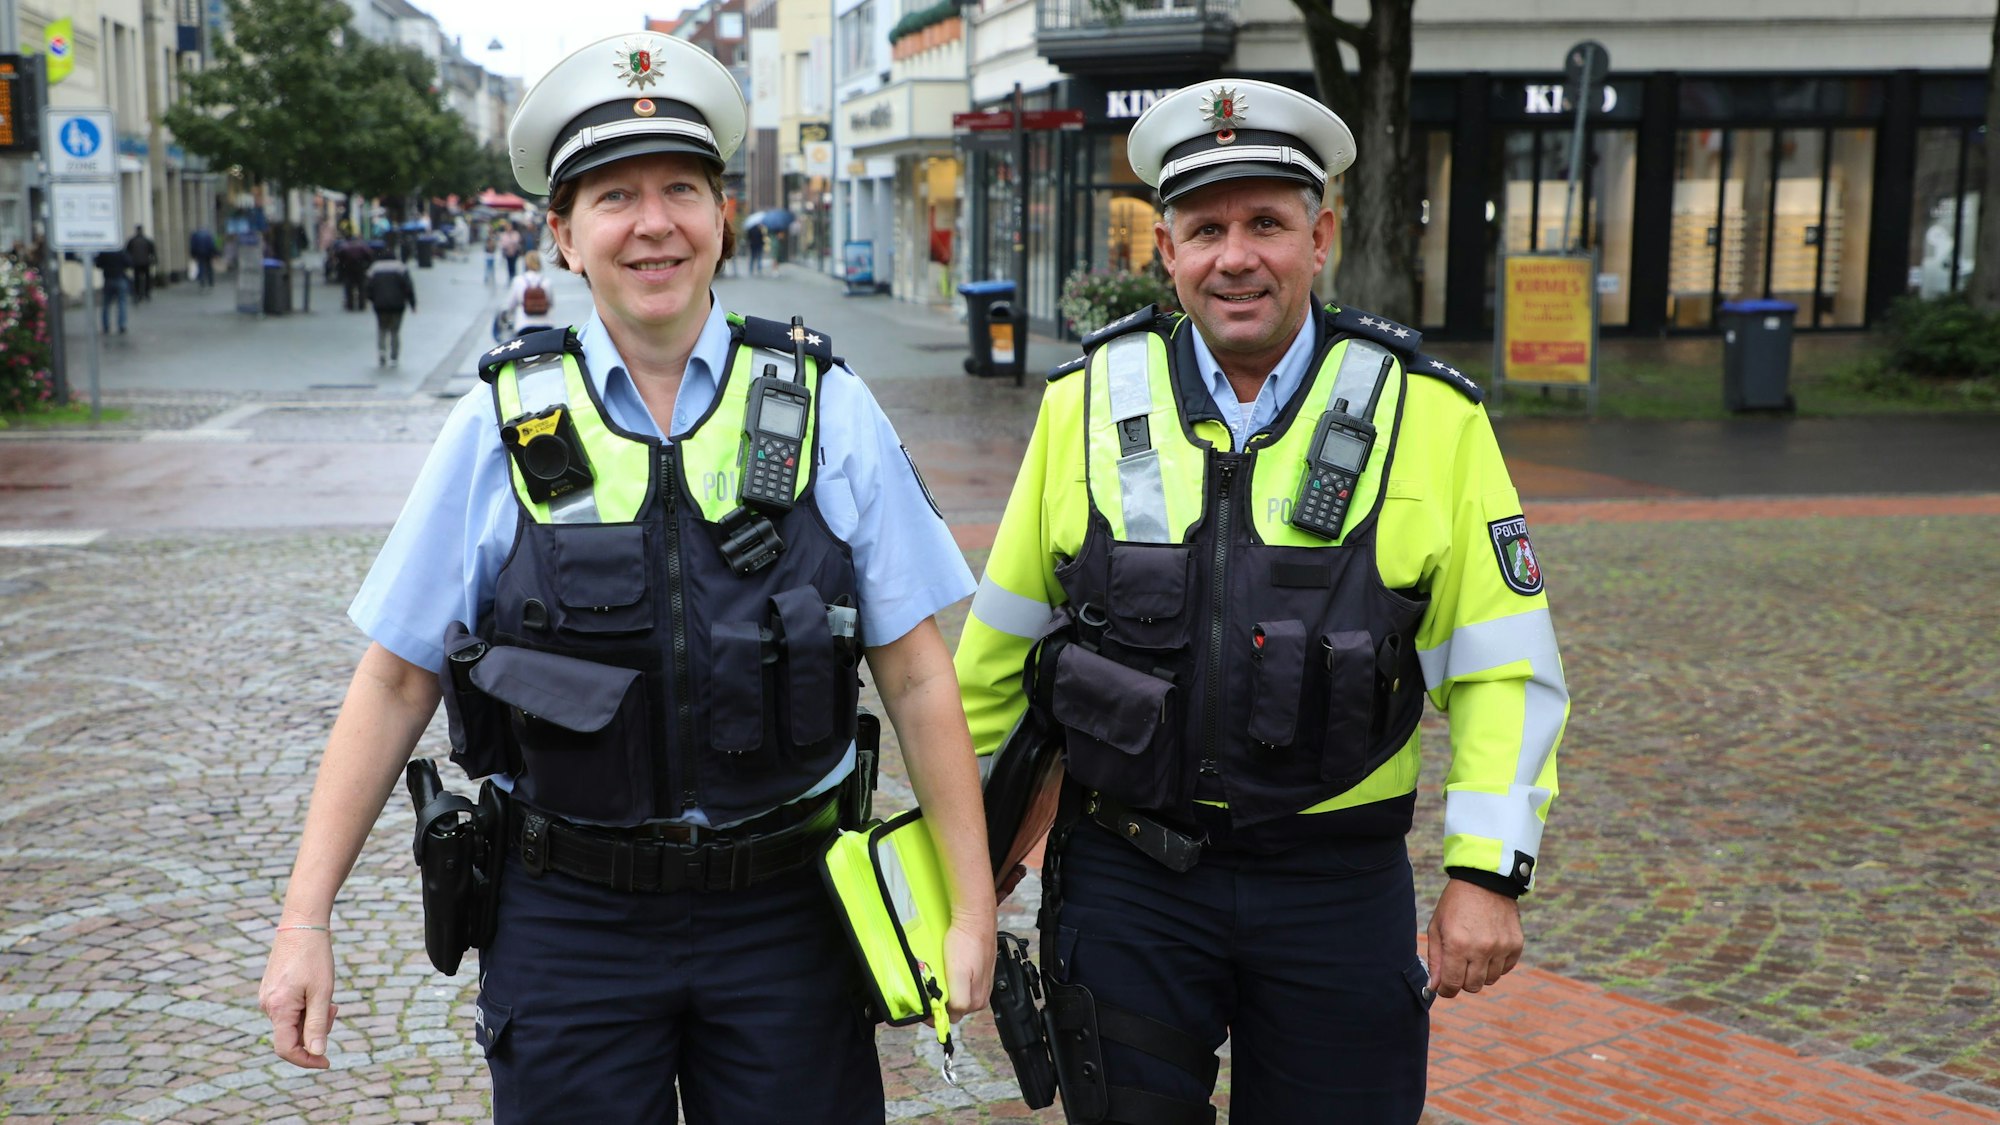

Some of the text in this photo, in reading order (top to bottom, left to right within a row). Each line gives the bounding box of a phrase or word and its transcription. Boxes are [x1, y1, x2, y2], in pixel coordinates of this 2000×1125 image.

[1106, 88, 1178, 118] KIN
[1525, 84, 1618, 113] KI
[703, 472, 738, 501] POL
[1267, 497, 1293, 525] PO
